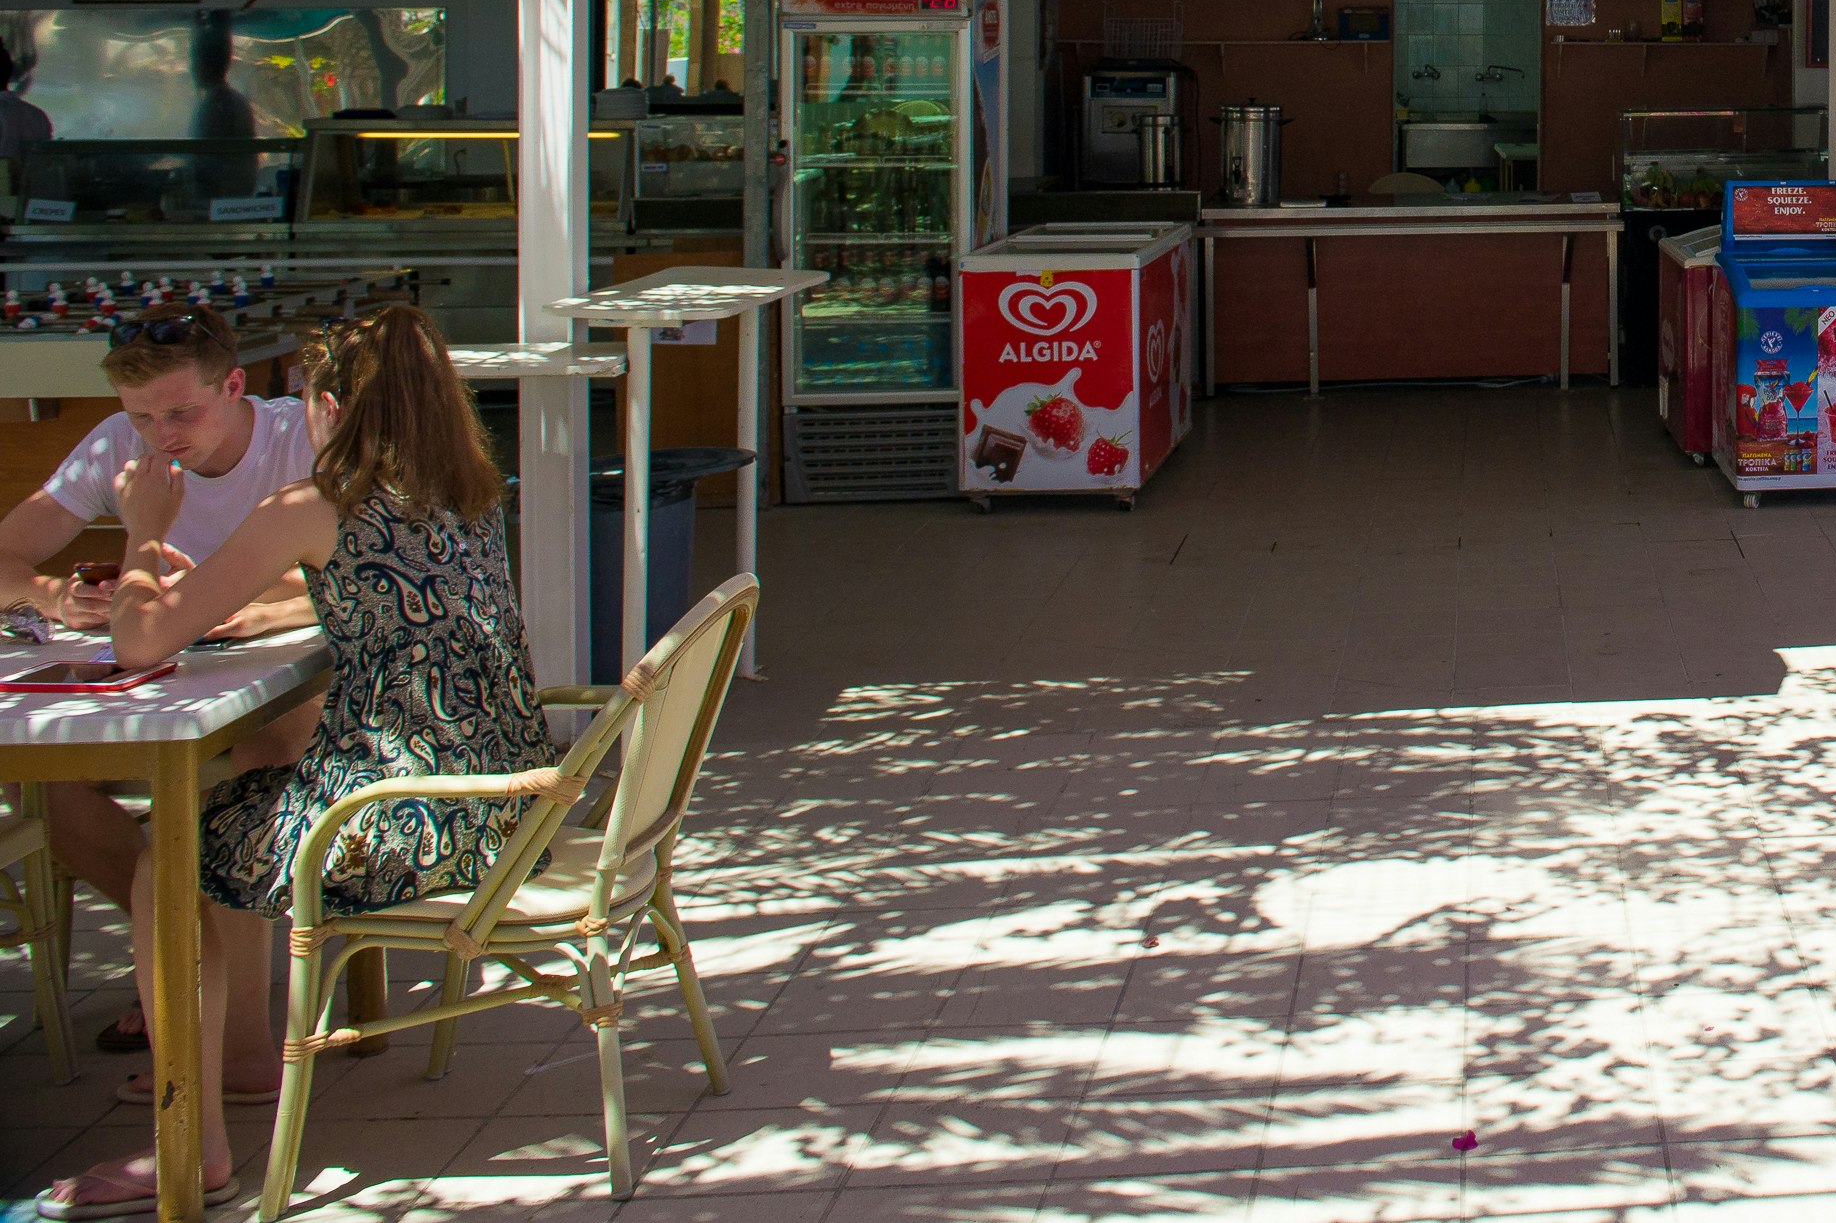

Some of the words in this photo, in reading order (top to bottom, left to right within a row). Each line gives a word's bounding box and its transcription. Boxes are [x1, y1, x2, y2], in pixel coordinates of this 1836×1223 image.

[1771, 187, 1807, 195] FREEZE.
[1767, 196, 1812, 205] SQUEEZE.
[1774, 206, 1806, 216] ENJOY.
[998, 340, 1098, 363] ALGIDA
